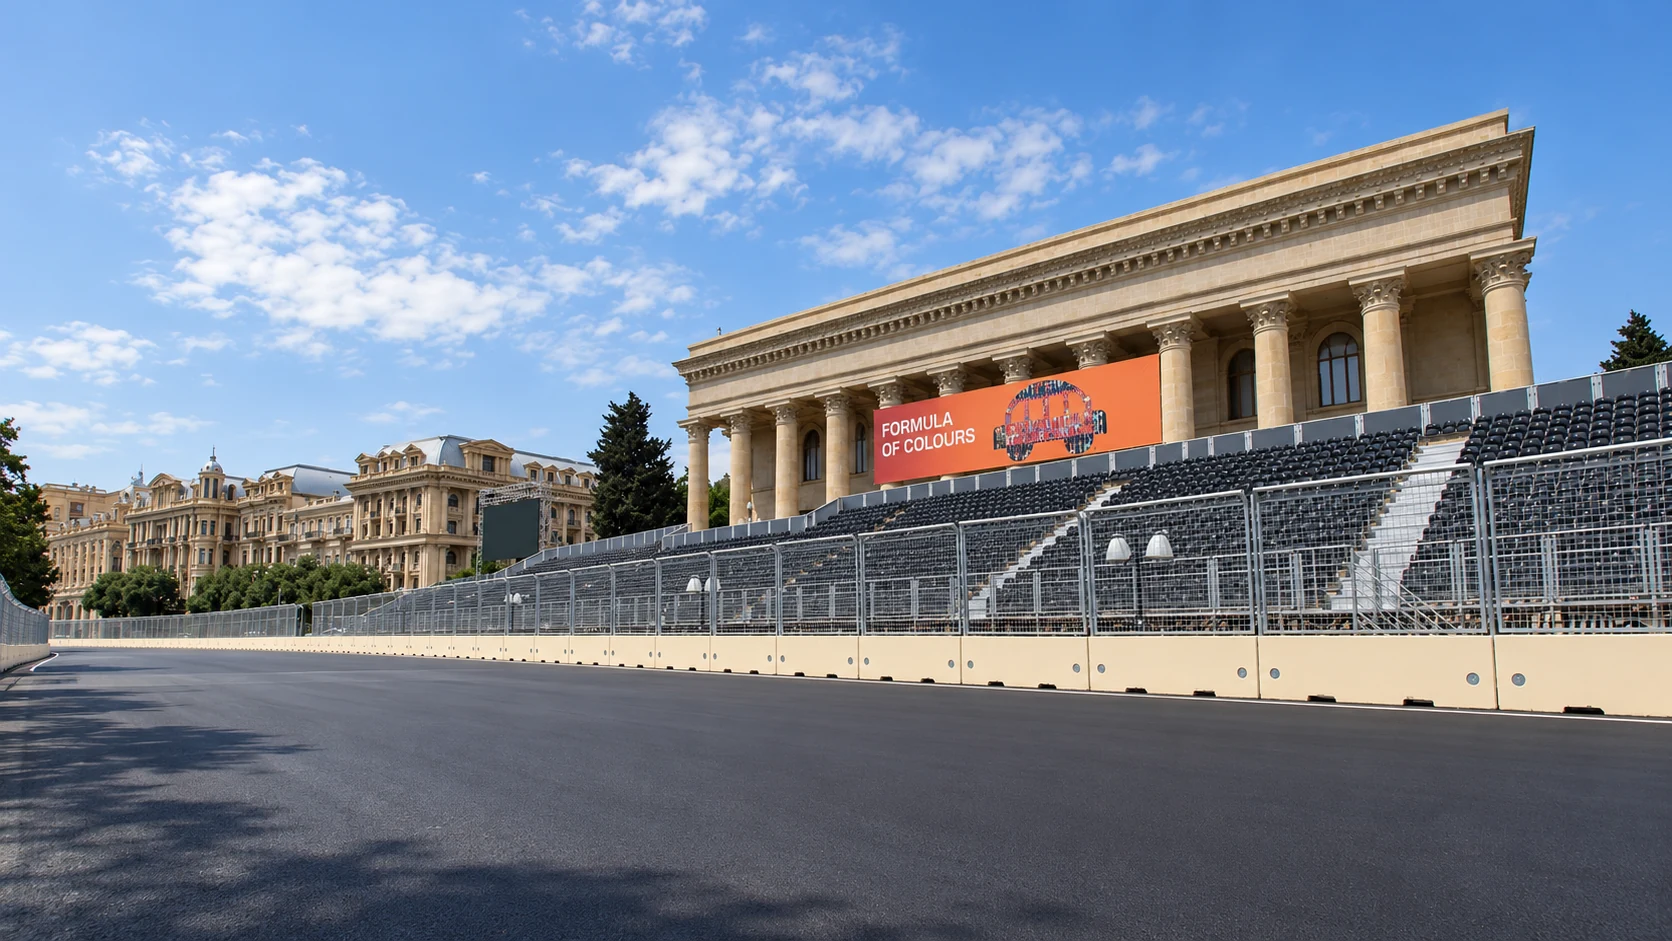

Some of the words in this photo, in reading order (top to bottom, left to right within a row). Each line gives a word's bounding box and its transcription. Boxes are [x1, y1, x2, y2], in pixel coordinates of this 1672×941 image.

[882, 411, 953, 438] FORMULA
[882, 441, 900, 457] OF
[904, 427, 975, 453] COLOURS
